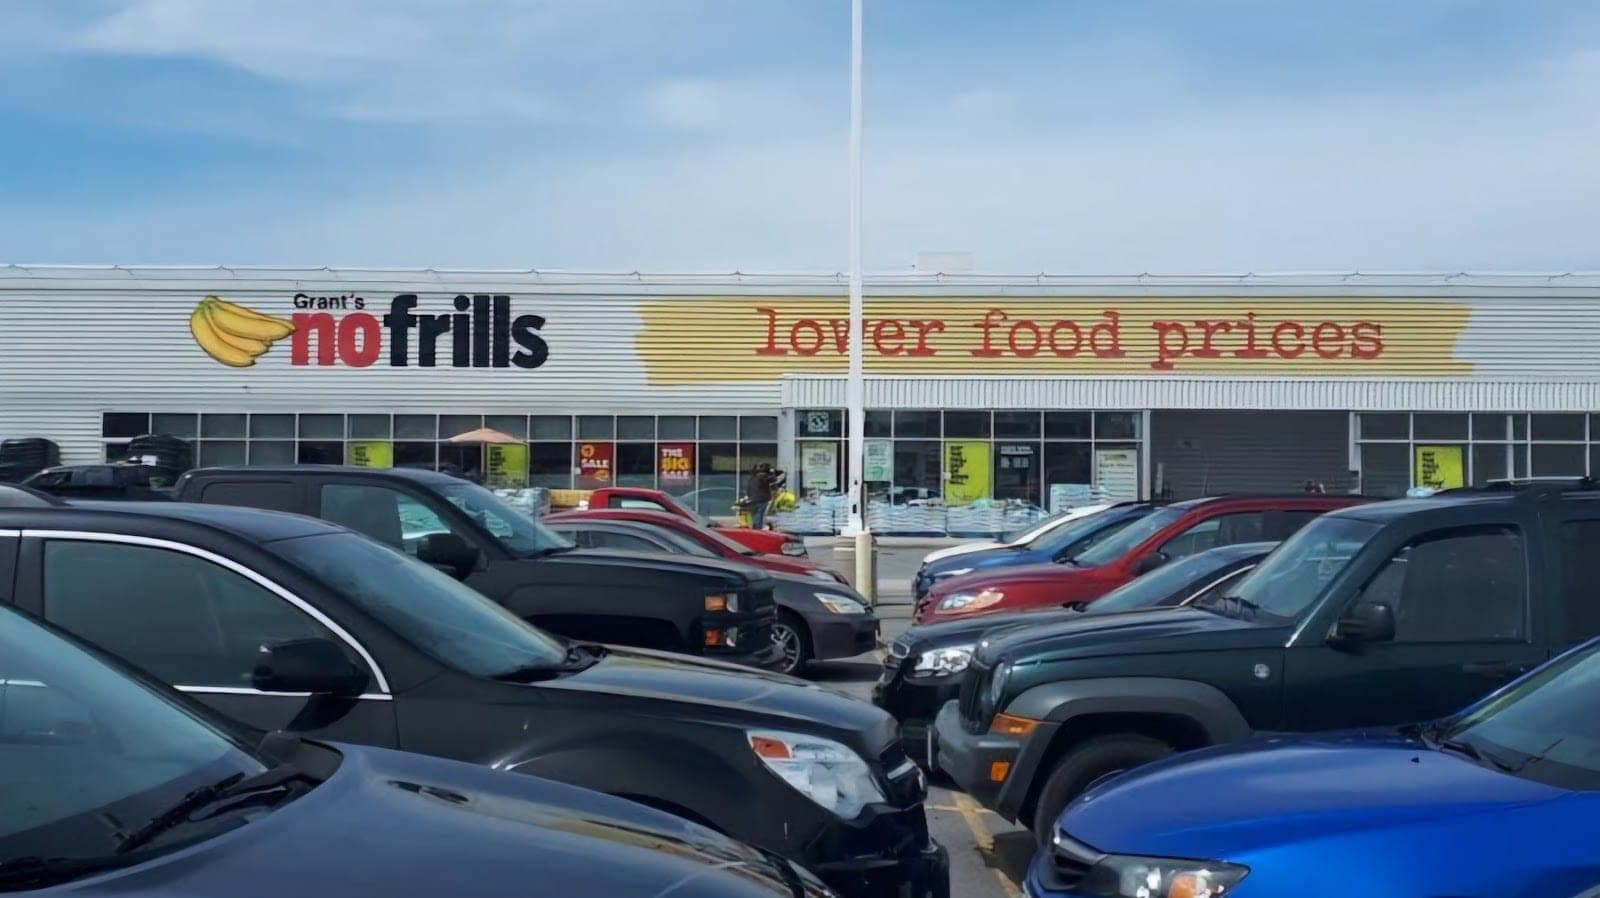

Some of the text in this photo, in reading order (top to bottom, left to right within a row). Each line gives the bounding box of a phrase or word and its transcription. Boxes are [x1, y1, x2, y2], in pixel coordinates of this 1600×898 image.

[293, 293, 365, 309] Grant's
[756, 307, 1385, 371] lower food prices
[581, 459, 608, 468] SALE
[661, 458, 689, 471] BIG
